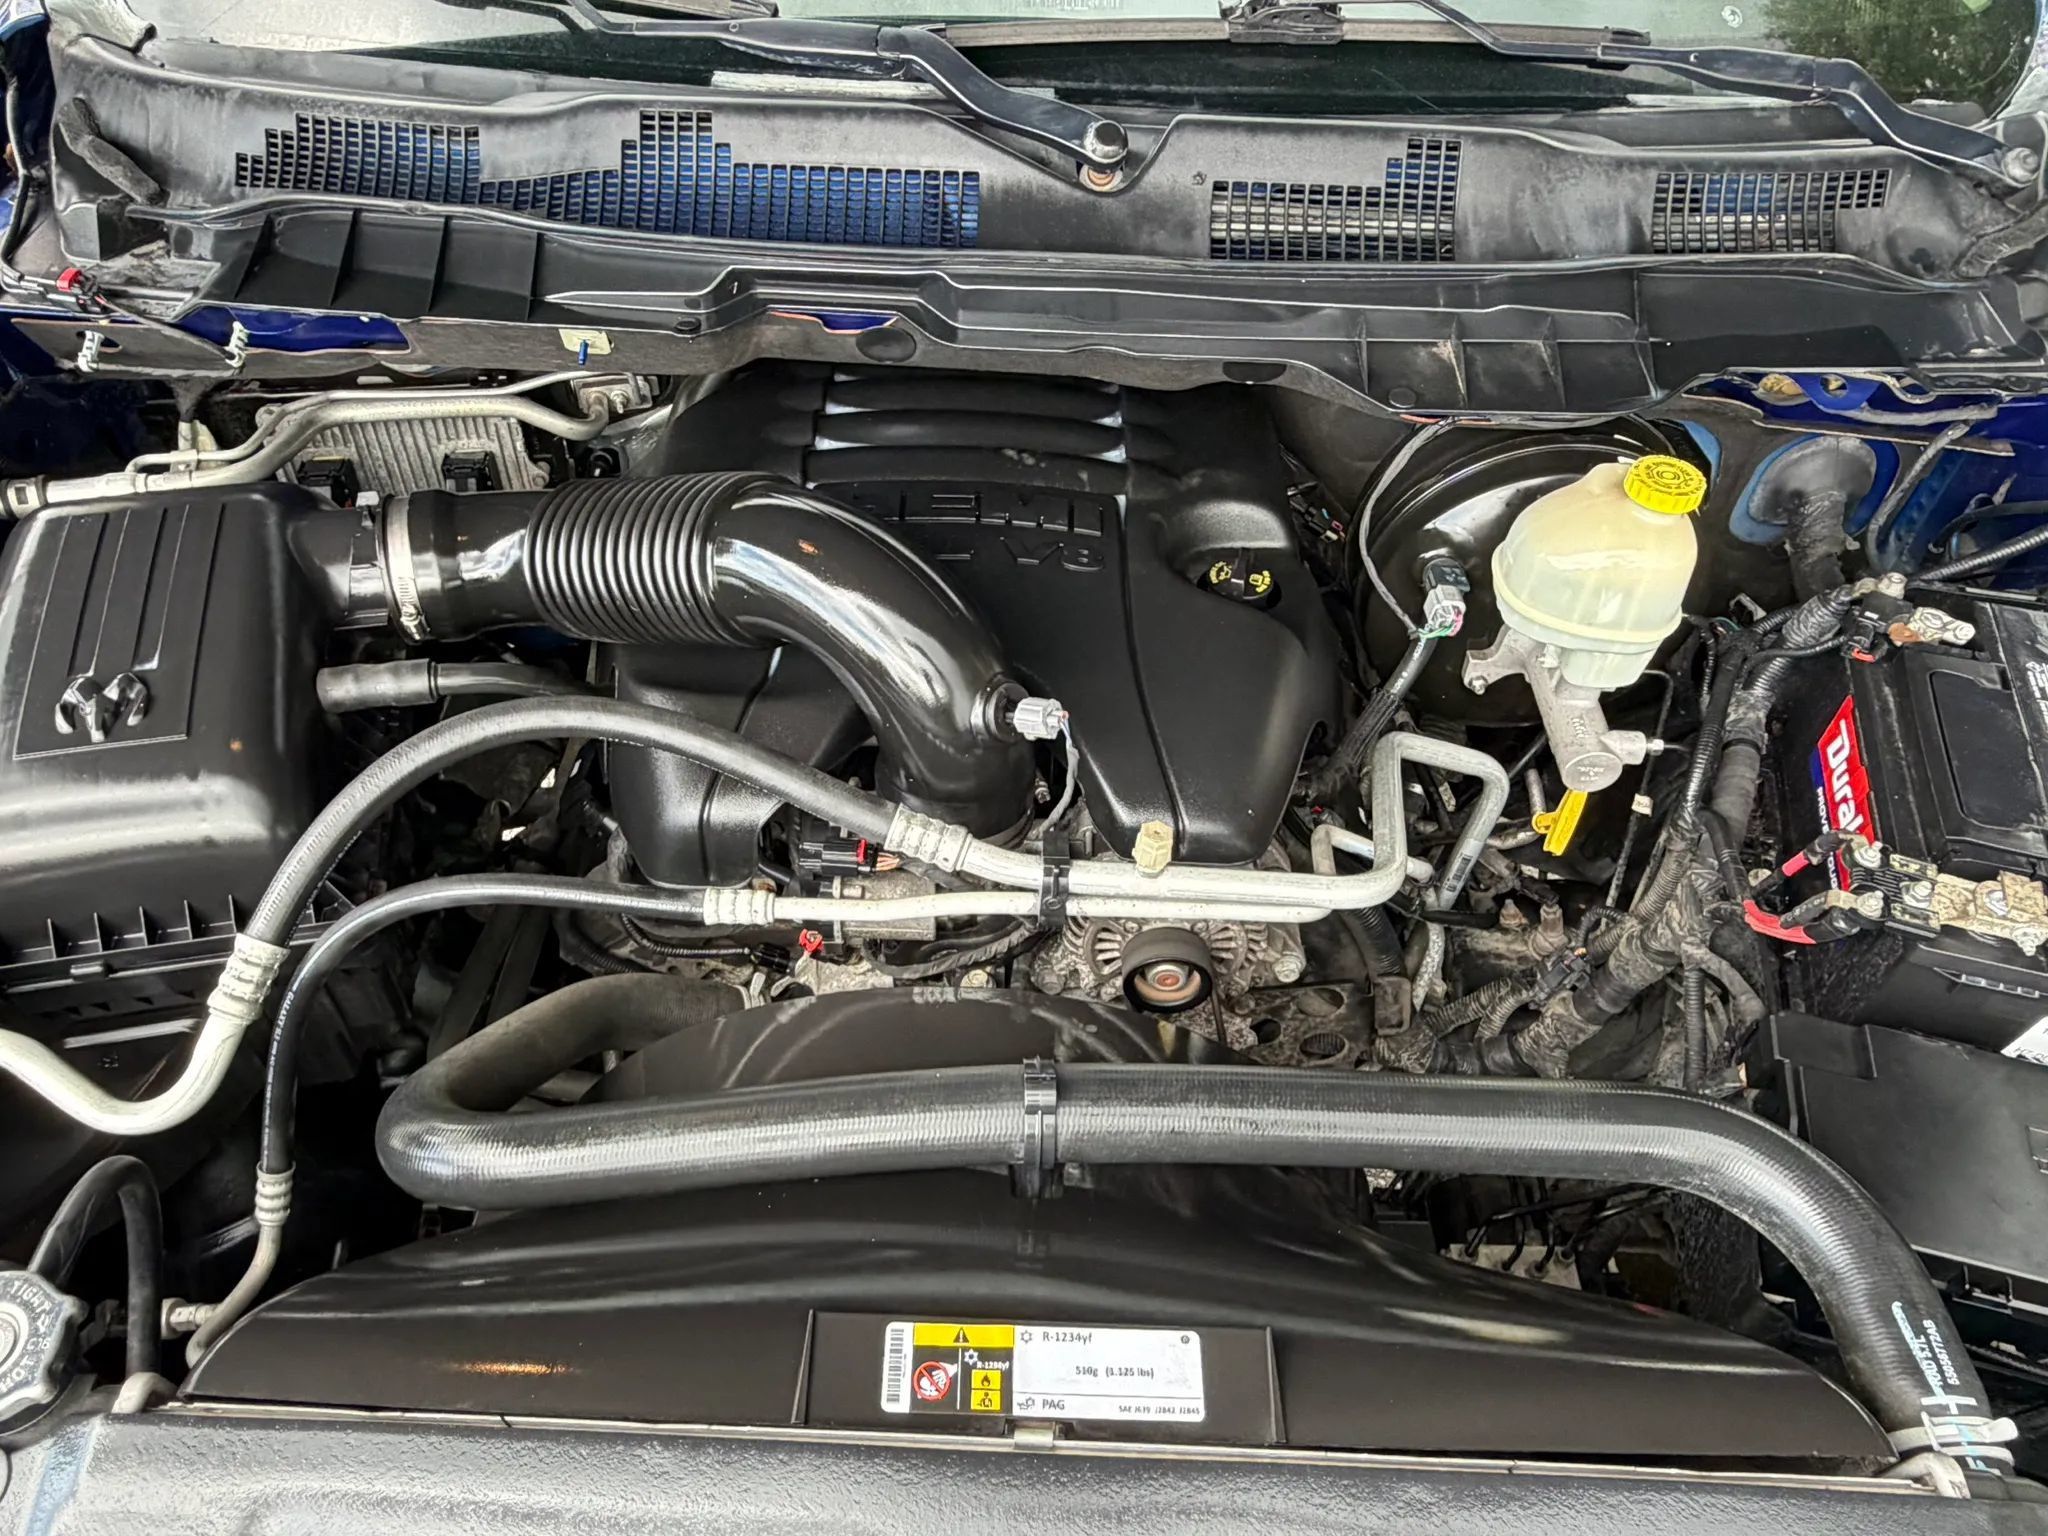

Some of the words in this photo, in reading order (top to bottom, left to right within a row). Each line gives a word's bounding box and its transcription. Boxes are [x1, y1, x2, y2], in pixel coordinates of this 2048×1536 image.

[1826, 718, 1864, 833] Dural
[1816, 786, 1831, 834] PROVE
[1042, 1331, 1093, 1345] R-1234yf
[1075, 1366, 1098, 1378] 510g
[1042, 1399, 1066, 1411] PAG
